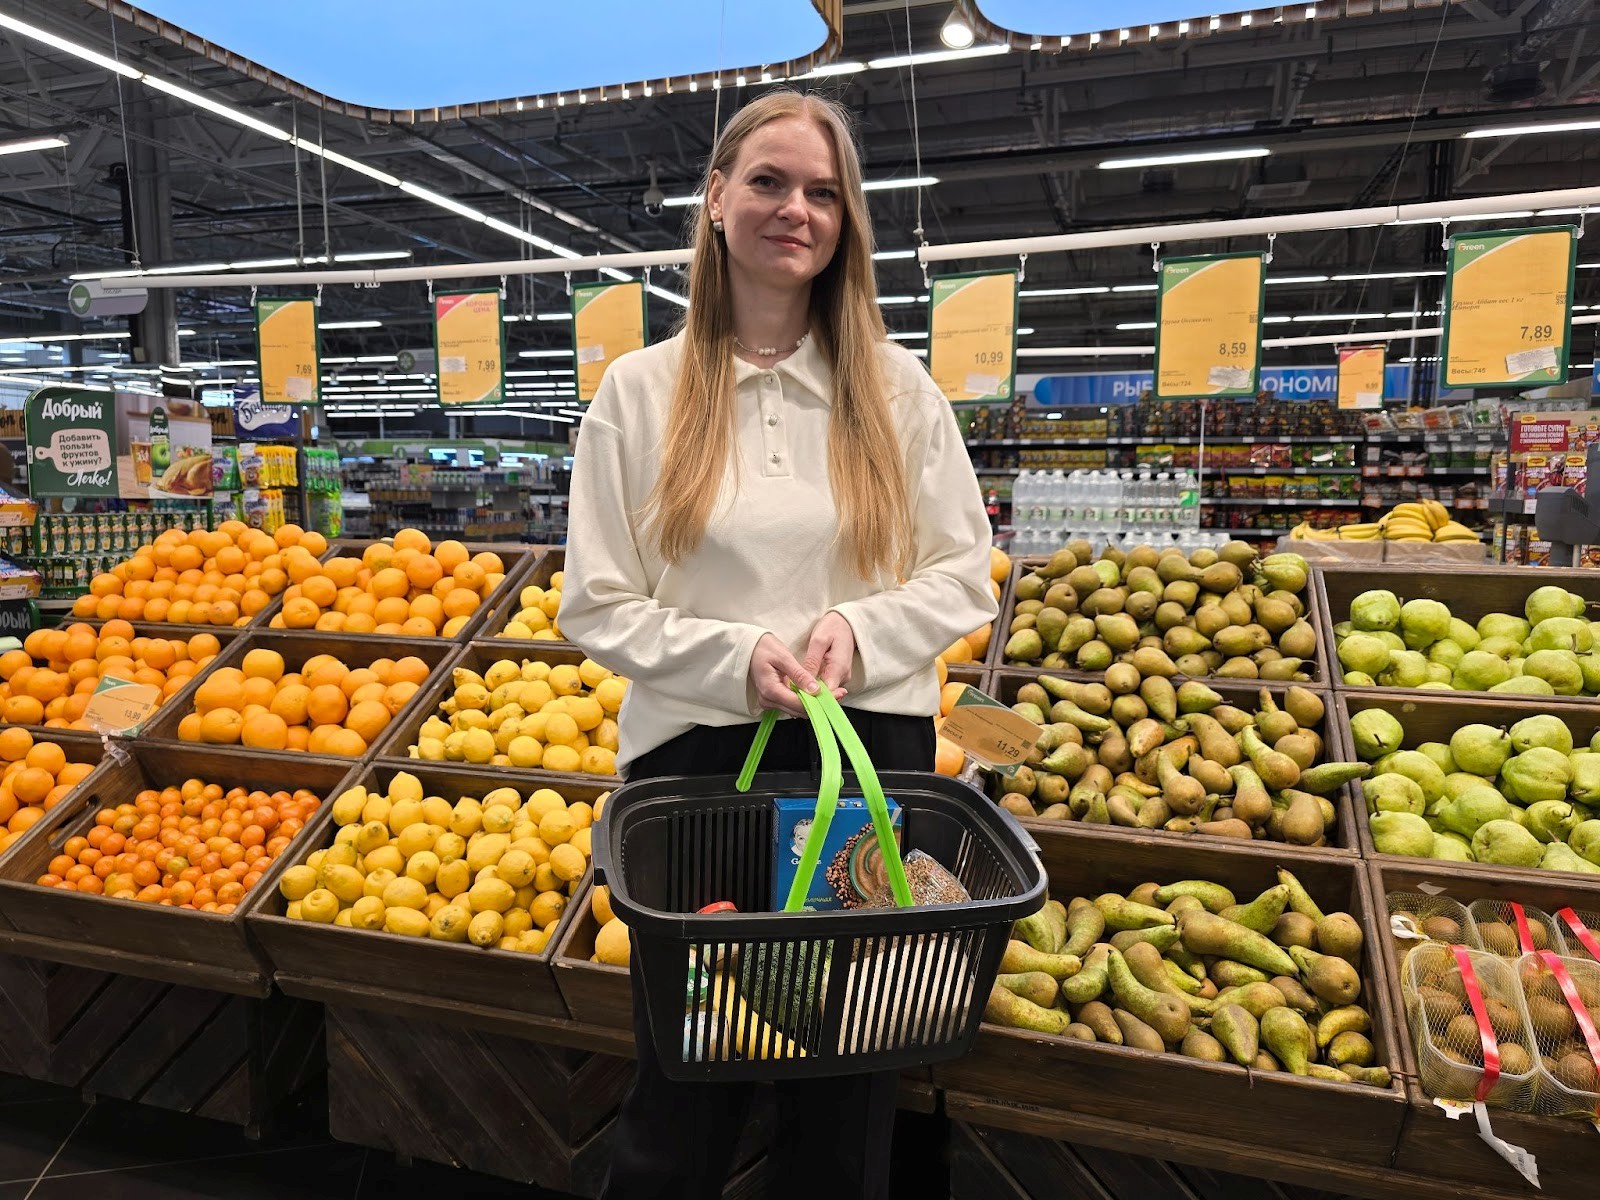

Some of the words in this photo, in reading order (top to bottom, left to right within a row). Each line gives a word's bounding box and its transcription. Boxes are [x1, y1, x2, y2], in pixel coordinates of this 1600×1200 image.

[1457, 243, 1485, 251] Green
[1520, 325, 1552, 341] 7,89
[1219, 342, 1247, 357] 8,59
[974, 351, 1003, 365] 10,99
[295, 364, 312, 375] 7,69
[478, 360, 496, 372] 7,99
[1259, 375, 1337, 393] ОНОМ
[41, 397, 103, 422] Добрый
[58, 434, 101, 443] Добавить
[60, 443, 93, 451] пользы
[61, 450, 99, 460] фруктов
[69, 457, 102, 468] ужину?
[67, 469, 113, 488] Легко!
[0, 607, 31, 630] рый
[996, 740, 1020, 758] 11,29
